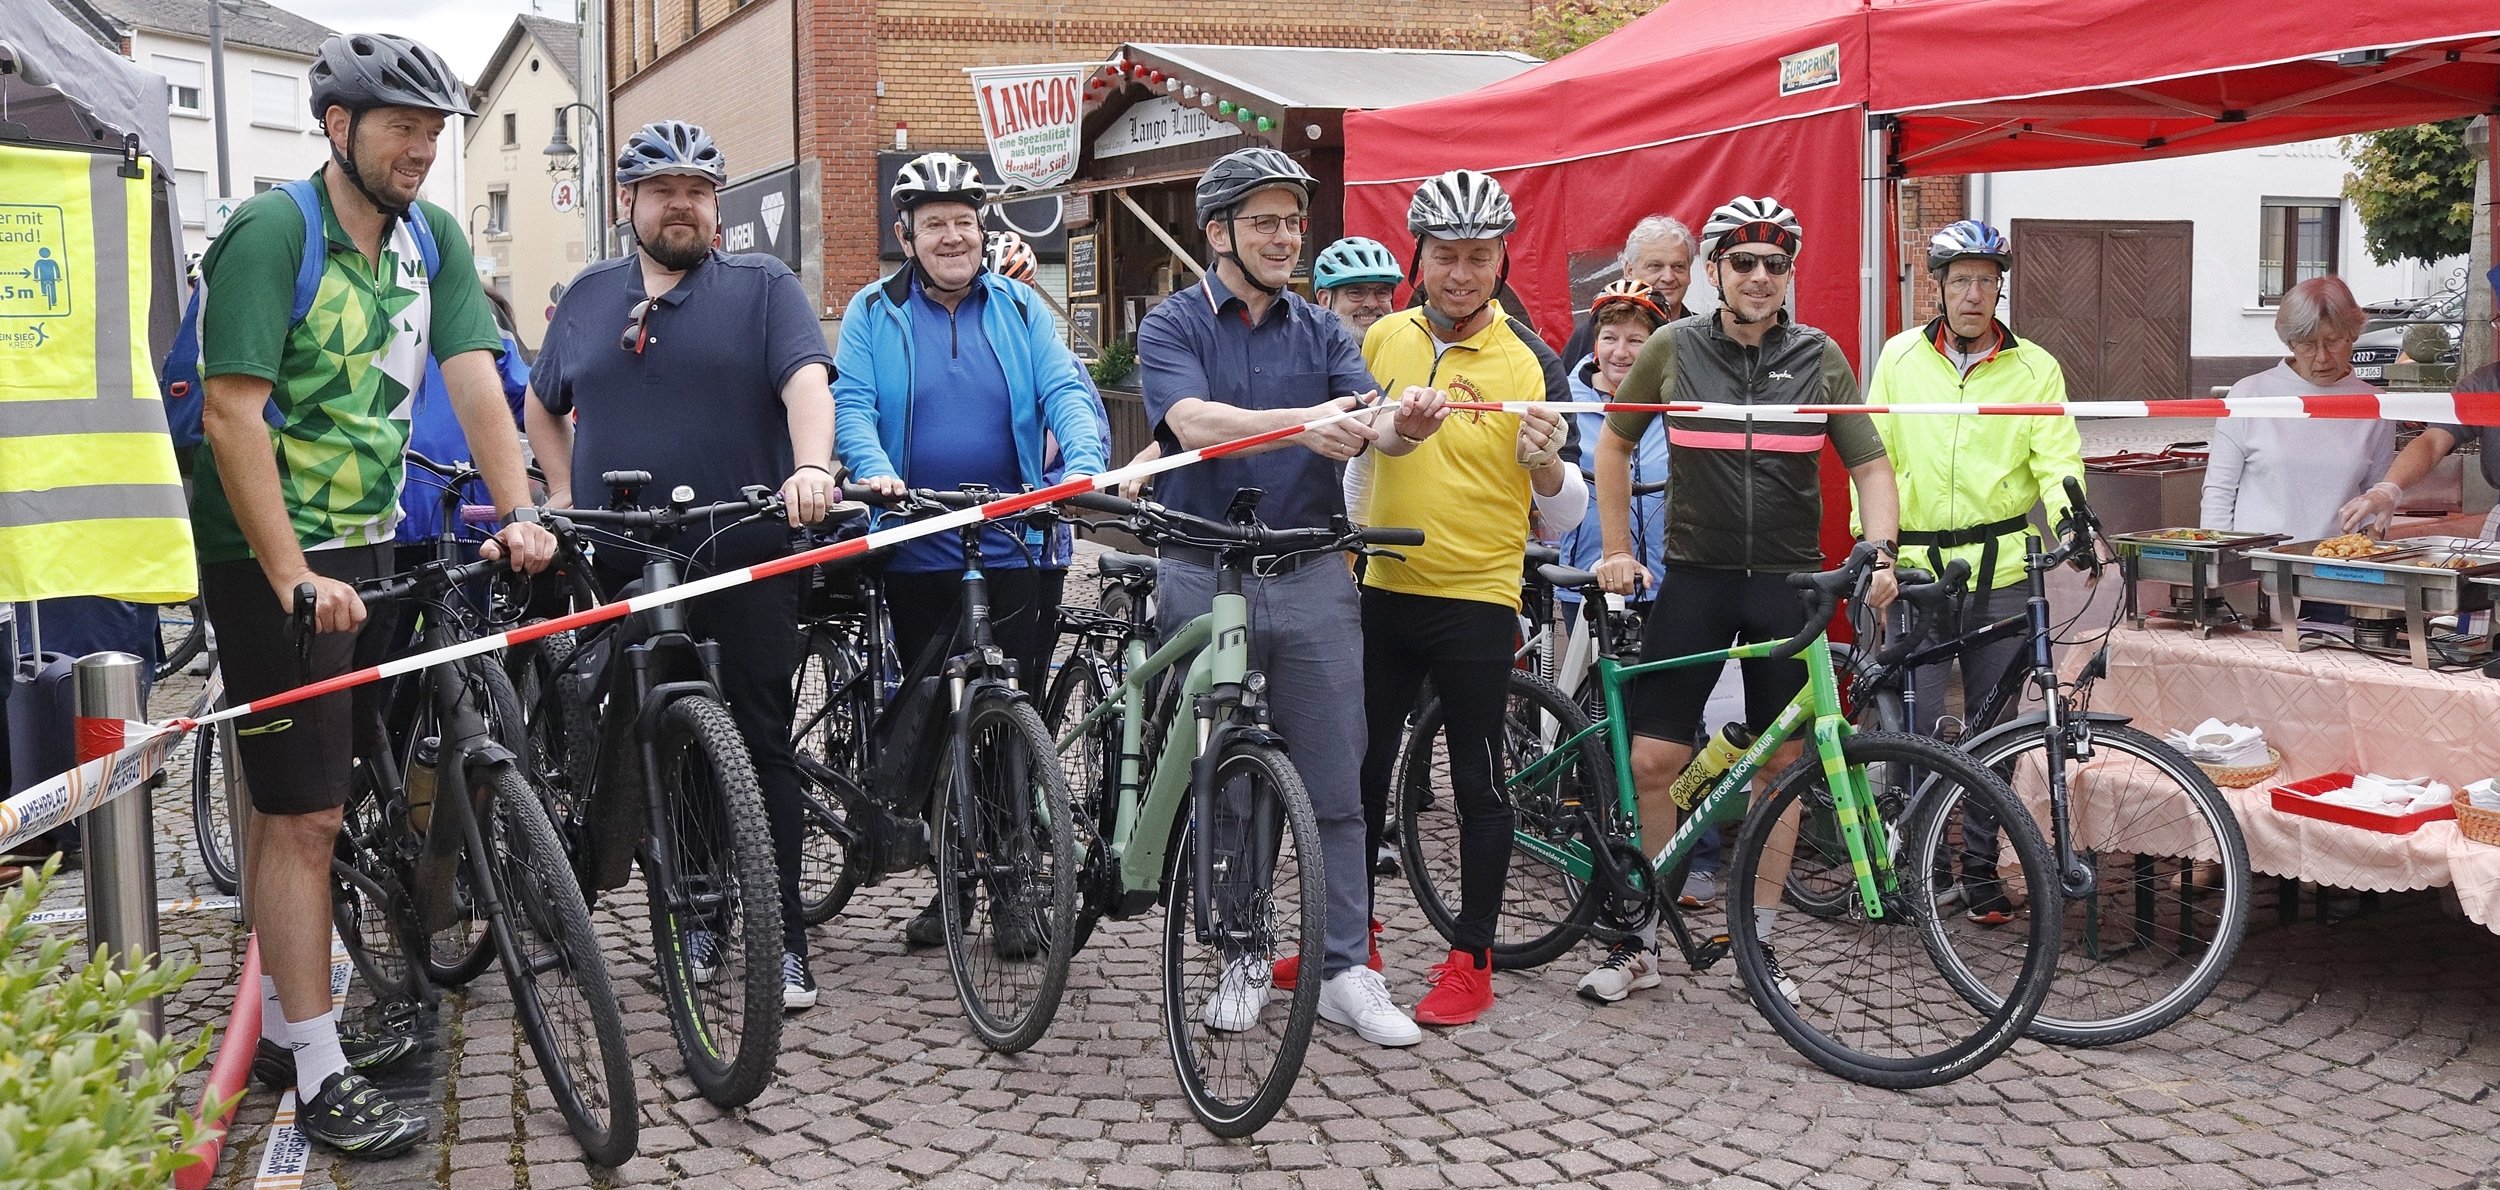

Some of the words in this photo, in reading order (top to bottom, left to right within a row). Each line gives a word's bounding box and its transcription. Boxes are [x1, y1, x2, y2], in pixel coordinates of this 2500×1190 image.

[981, 76, 1077, 139] LANGOS
[999, 139, 1016, 149] eine
[1018, 127, 1071, 148] Spezialität
[1010, 148, 1026, 158] aus
[1028, 140, 1067, 157] Ungarn!
[1031, 167, 1048, 178] oder
[1049, 152, 1070, 173] Süß!
[16, 211, 43, 225] mit
[725, 221, 755, 252] UHREN
[18, 288, 34, 299] m
[9, 341, 34, 349] KREIS
[14, 333, 35, 341] SIEG
[1652, 795, 1713, 871] GIANT
[1711, 777, 1736, 802] STORE
[1734, 733, 1776, 780] MONTABAUR
[1513, 834, 1568, 867] ir-westerwaelder.de
[267, 1126, 293, 1174] #MEHRPLATZ
